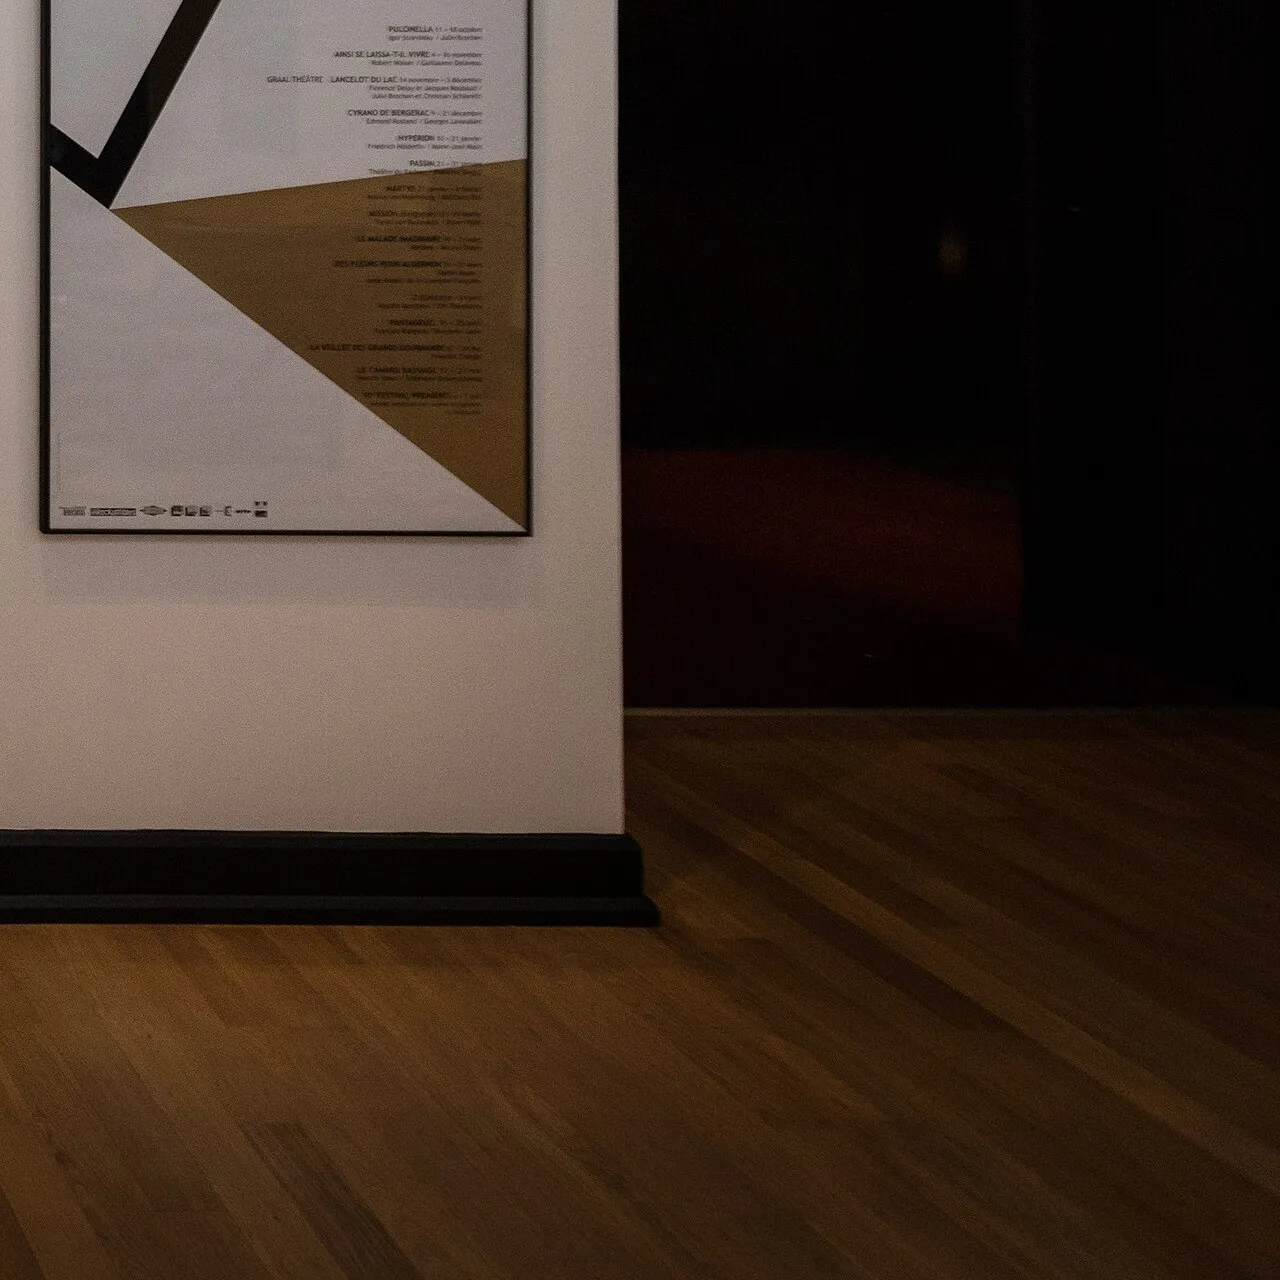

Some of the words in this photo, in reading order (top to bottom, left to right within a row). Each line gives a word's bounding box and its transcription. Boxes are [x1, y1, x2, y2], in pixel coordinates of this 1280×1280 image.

[347, 109, 378, 117] CYRANO
[379, 109, 390, 117] DE
[391, 109, 430, 117] BERGERAC
